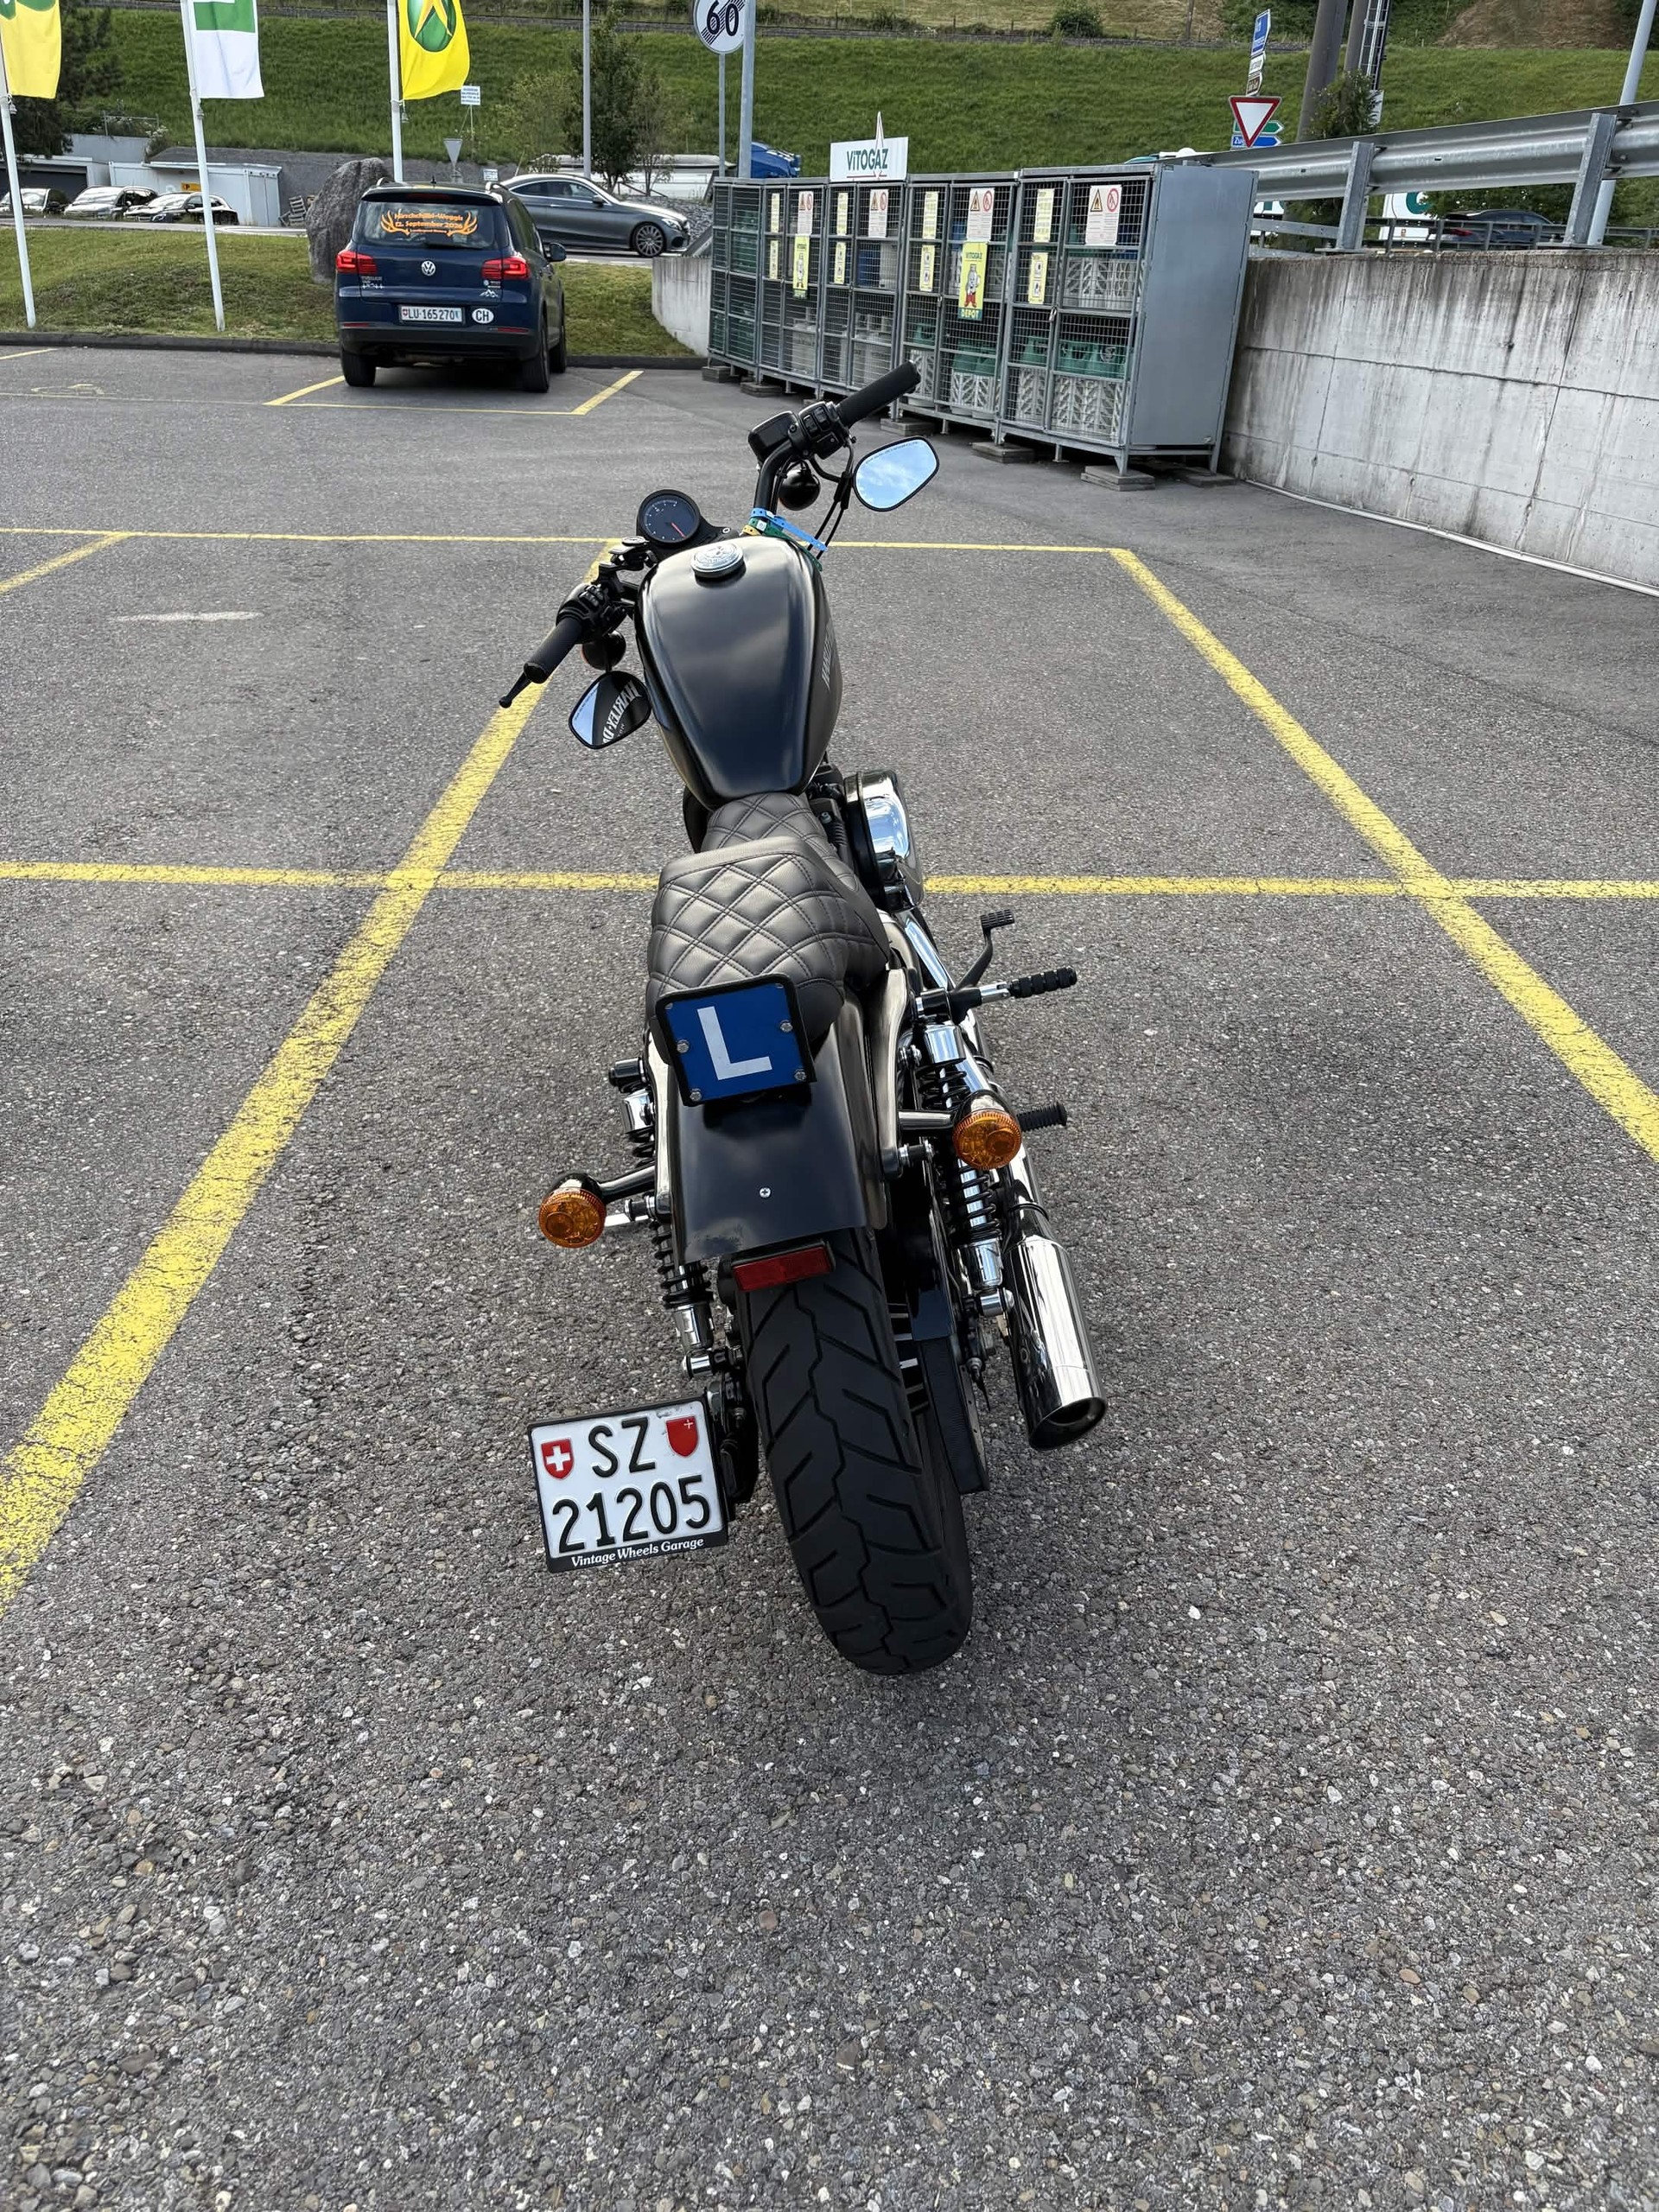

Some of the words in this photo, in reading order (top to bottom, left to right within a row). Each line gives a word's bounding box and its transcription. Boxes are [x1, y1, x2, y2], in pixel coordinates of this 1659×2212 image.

[707, 2, 739, 36] 60
[475, 309, 489, 321] CH
[697, 1006, 772, 1080] L
[588, 1417, 656, 1478] SZ
[552, 1475, 710, 1554] 21205
[571, 1552, 616, 1567] Vintage
[617, 1543, 659, 1560] Wheels
[660, 1538, 704, 1553] Garage
